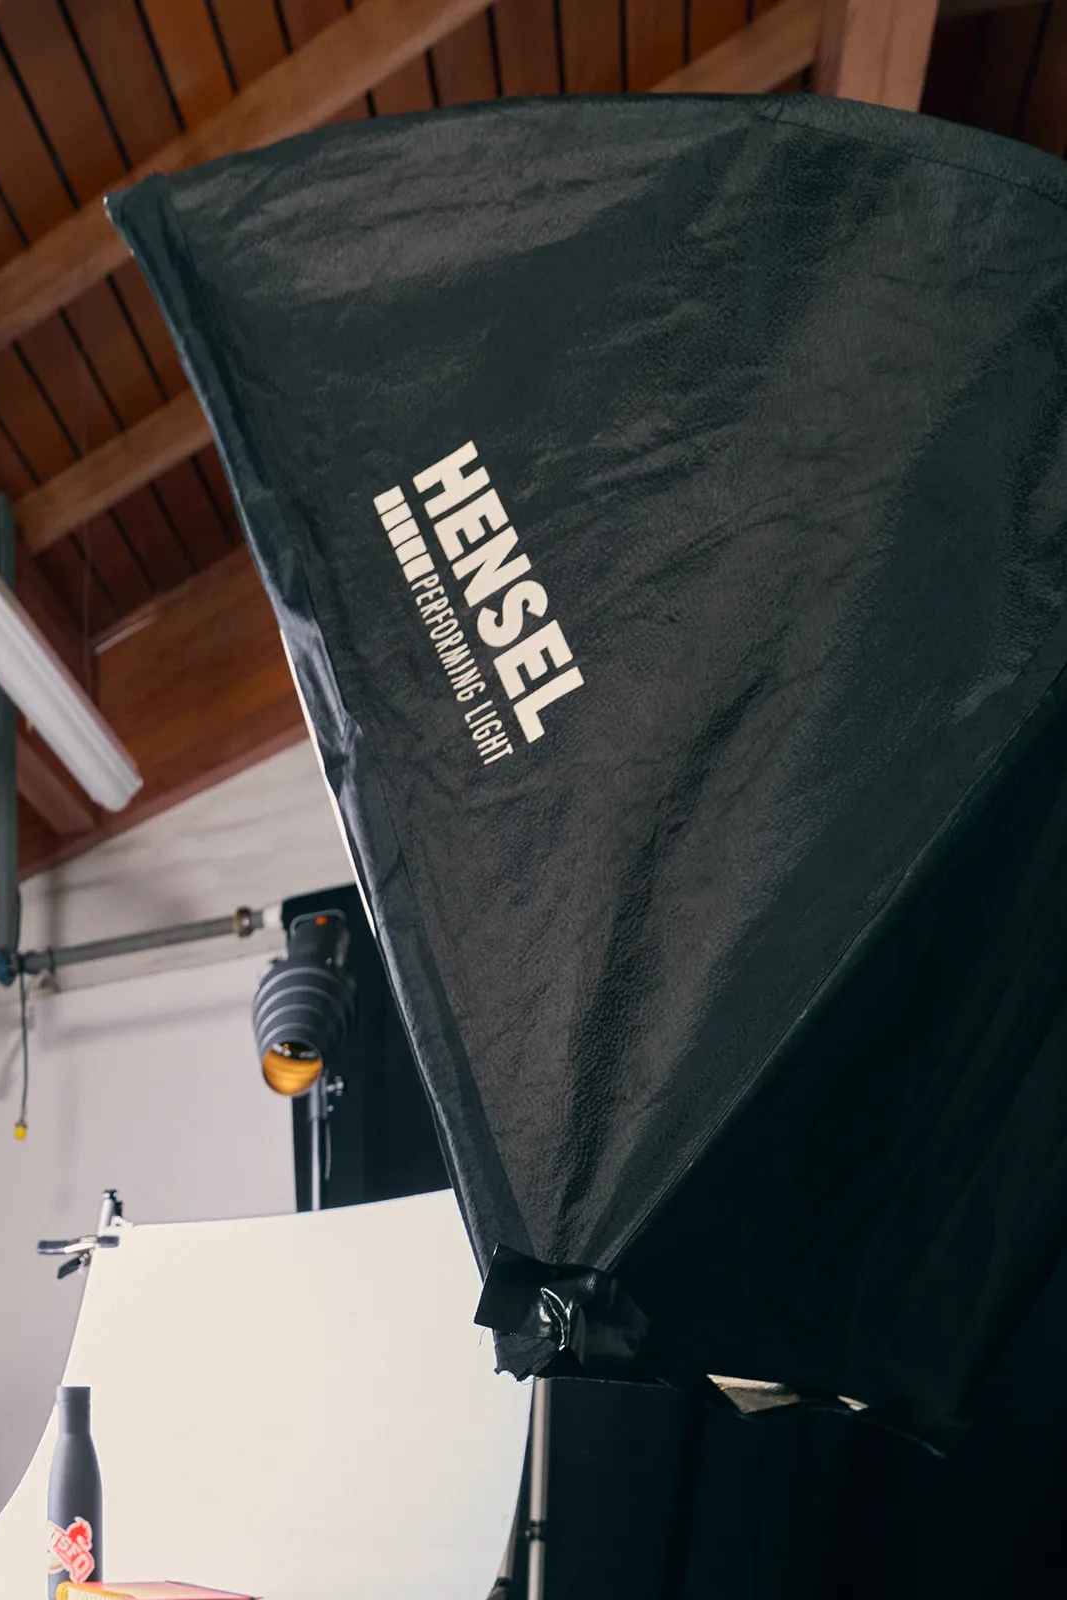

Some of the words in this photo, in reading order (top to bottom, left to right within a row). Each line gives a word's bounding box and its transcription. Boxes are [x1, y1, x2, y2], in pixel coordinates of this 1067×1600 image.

[410, 574, 486, 702] PERFORMING
[464, 700, 513, 765] LIGHT
[413, 440, 584, 743] HENSEL
